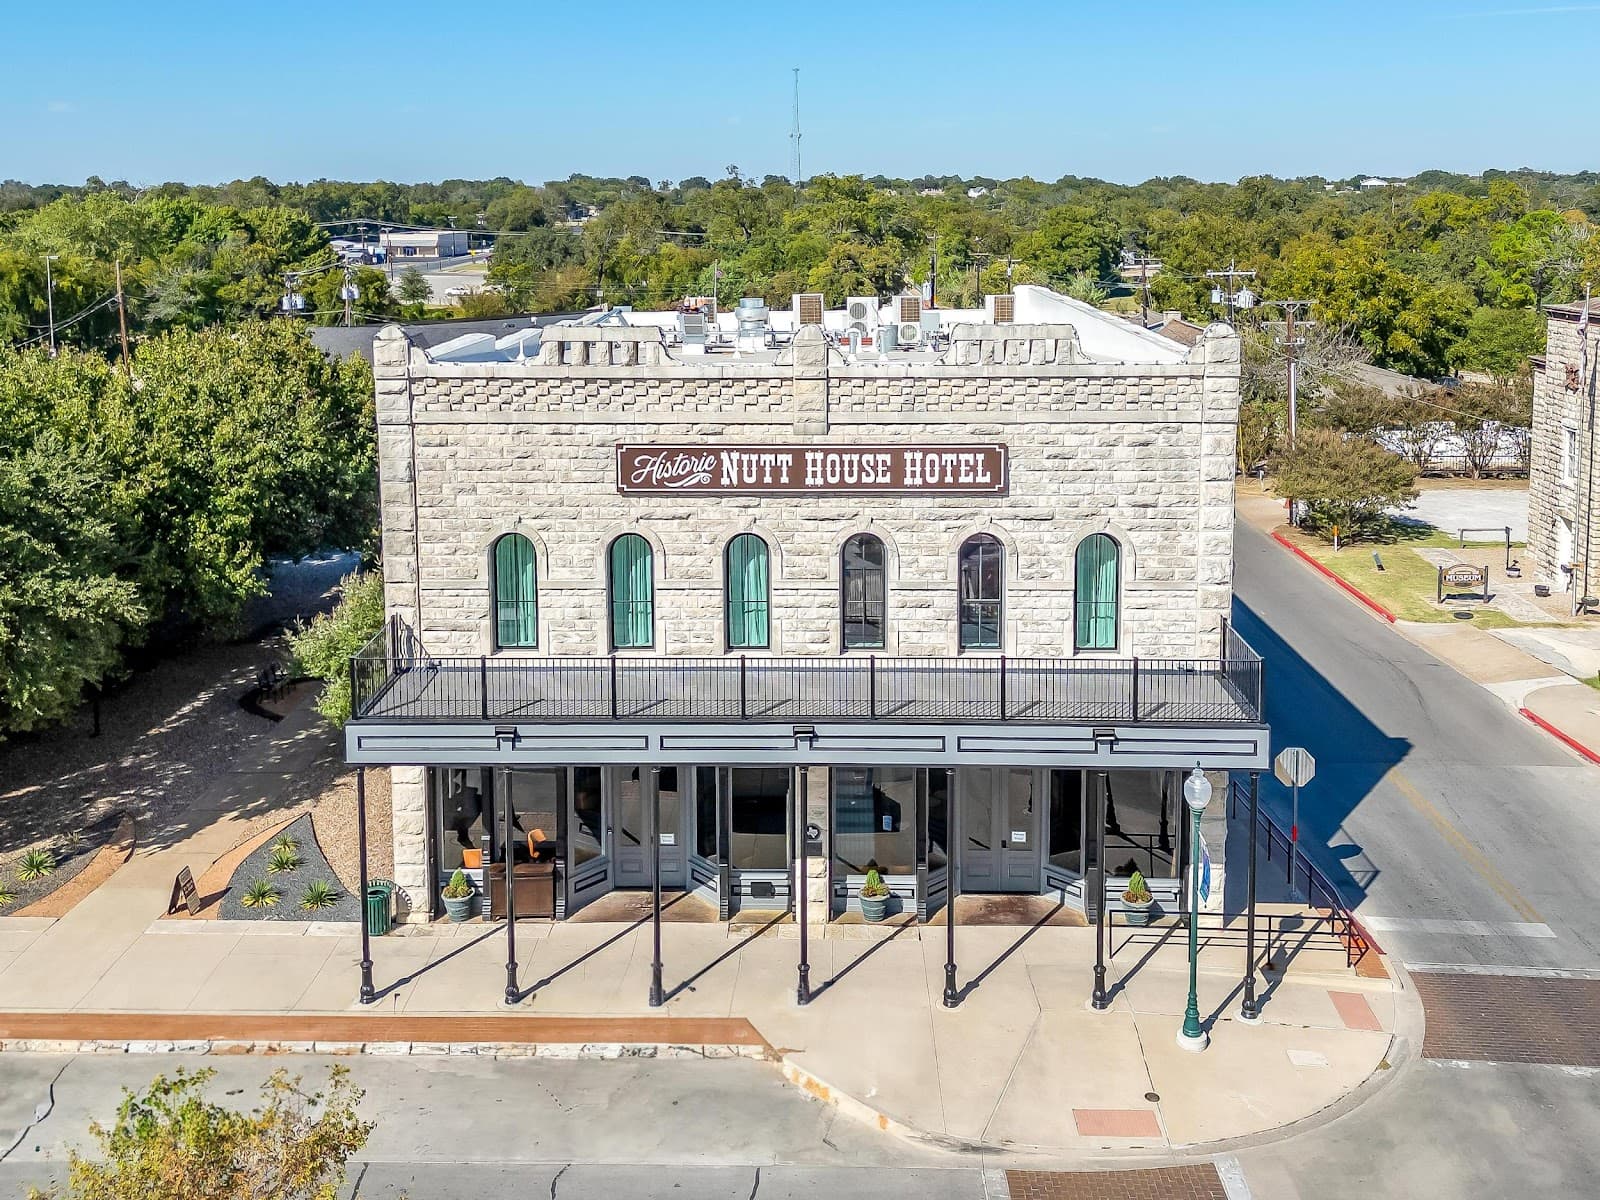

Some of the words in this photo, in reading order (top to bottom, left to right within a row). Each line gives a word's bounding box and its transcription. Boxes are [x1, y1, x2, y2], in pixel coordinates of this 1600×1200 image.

[631, 451, 717, 487] Historic
[720, 450, 793, 487] NUTT
[805, 450, 891, 487] HOUSE
[903, 450, 991, 487] HOTEL
[1446, 574, 1480, 582] MUSEUM
